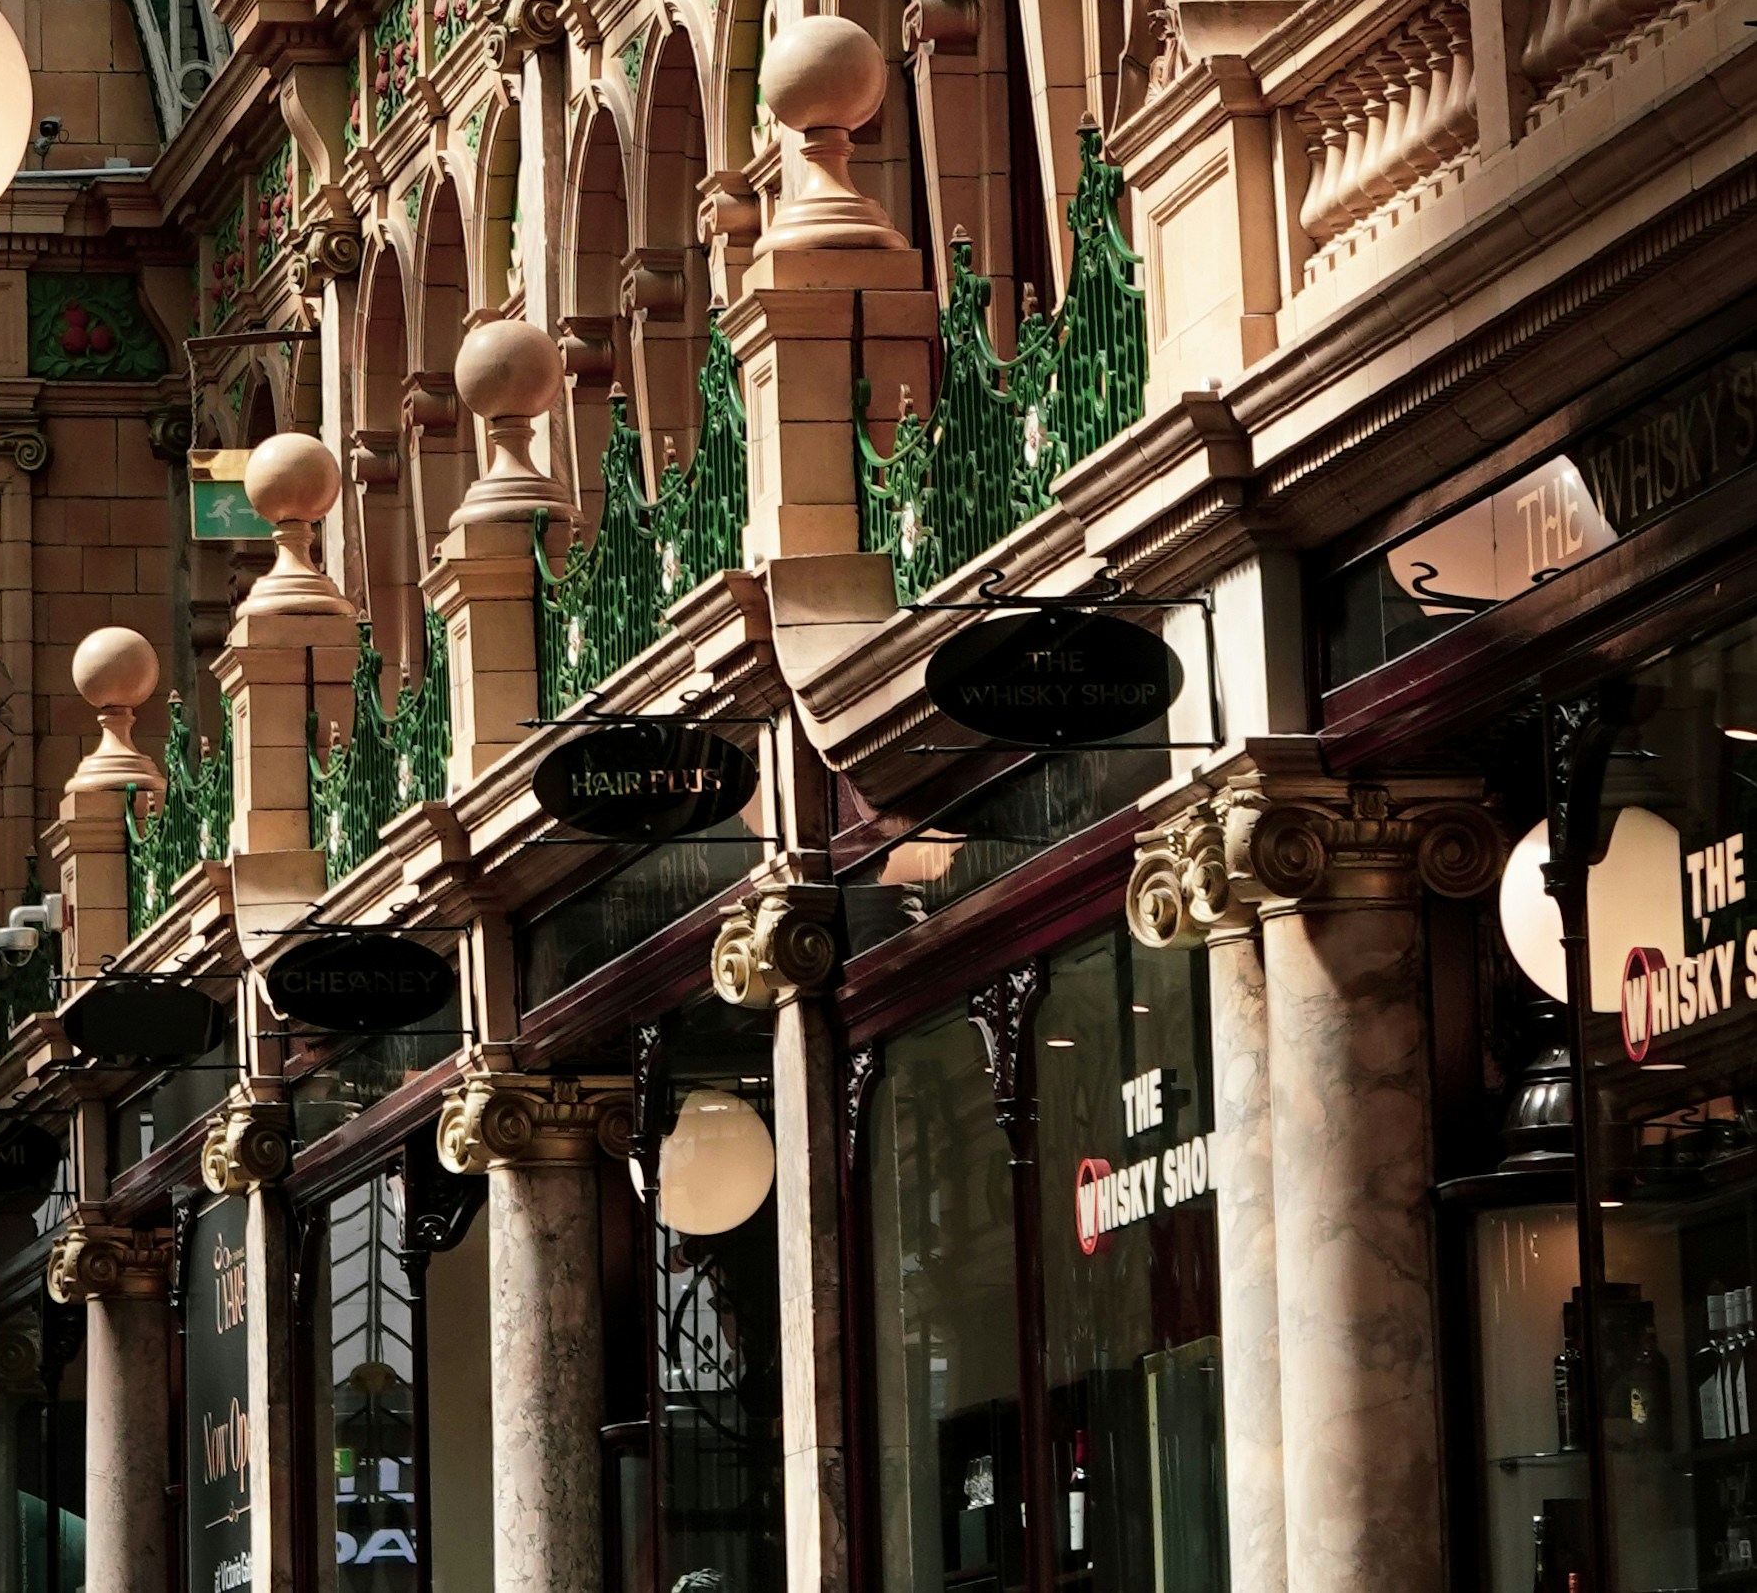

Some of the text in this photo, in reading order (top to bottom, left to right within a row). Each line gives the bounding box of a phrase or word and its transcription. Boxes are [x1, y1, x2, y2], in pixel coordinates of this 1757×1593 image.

[1516, 476, 1585, 576] THE
[1588, 381, 1725, 532] WHISKY
[958, 683, 1157, 707] WHISKY SHOP
[1025, 651, 1086, 673] THE
[571, 768, 722, 797] HAIR PLUS
[1686, 832, 1746, 920] THE
[281, 969, 441, 996] CHEANEY
[1625, 939, 1736, 1044] WHISKY
[1121, 1067, 1164, 1139] THE
[1079, 1156, 1157, 1238] WHISKY
[203, 1411, 229, 1486] Now
